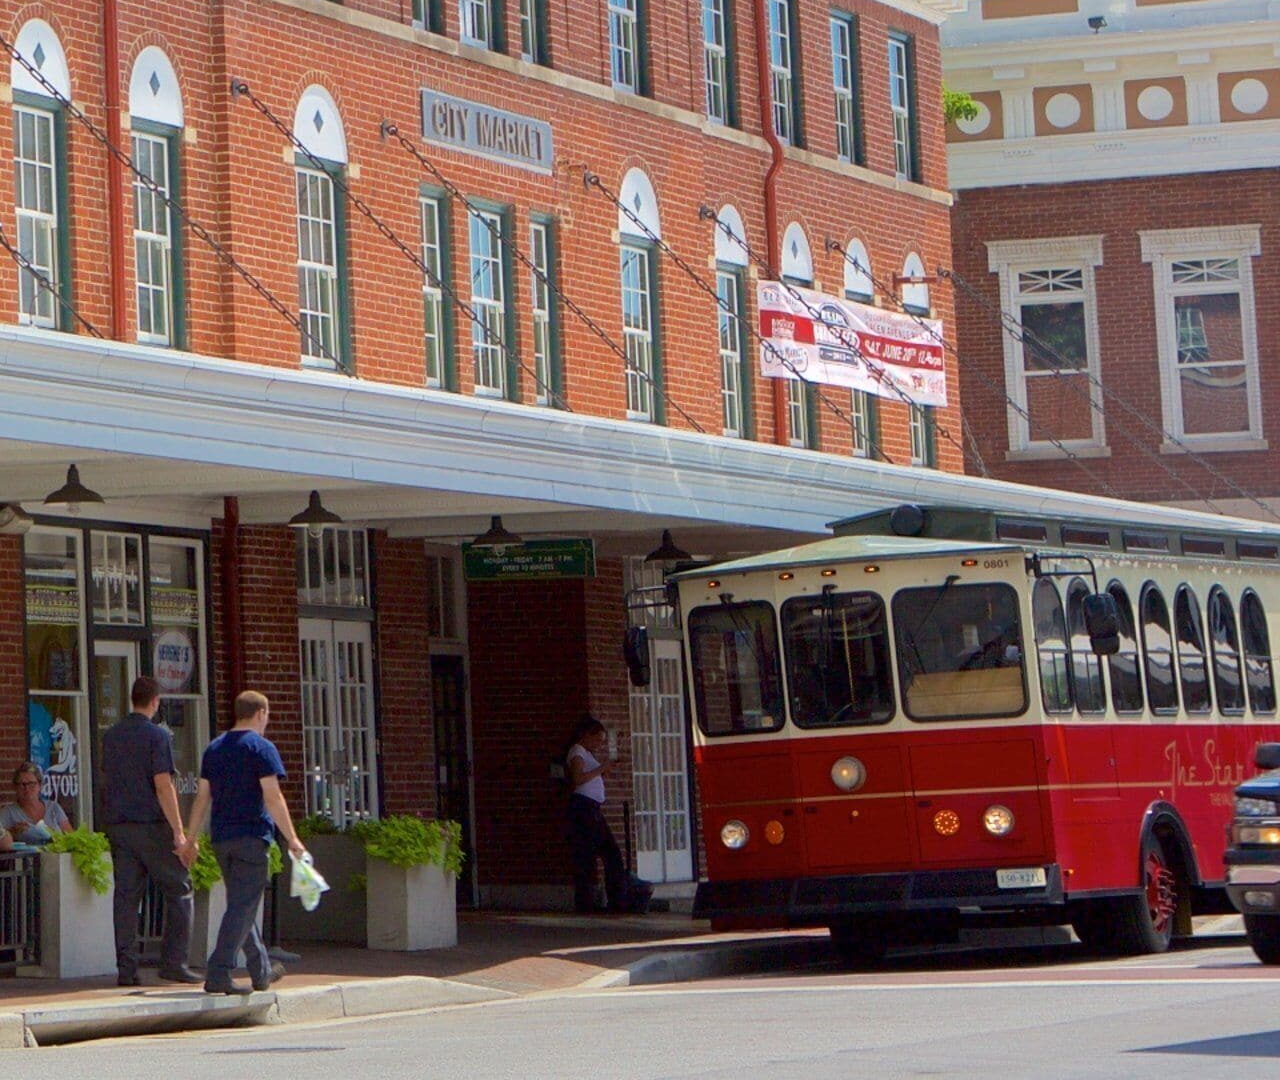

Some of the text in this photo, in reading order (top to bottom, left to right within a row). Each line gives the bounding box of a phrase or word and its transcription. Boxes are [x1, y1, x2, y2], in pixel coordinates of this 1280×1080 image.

[432, 99, 543, 160] CITY MARKET
[984, 560, 1009, 569] 0801
[1204, 738, 1244, 787] Star
[39, 773, 79, 803] ayou
